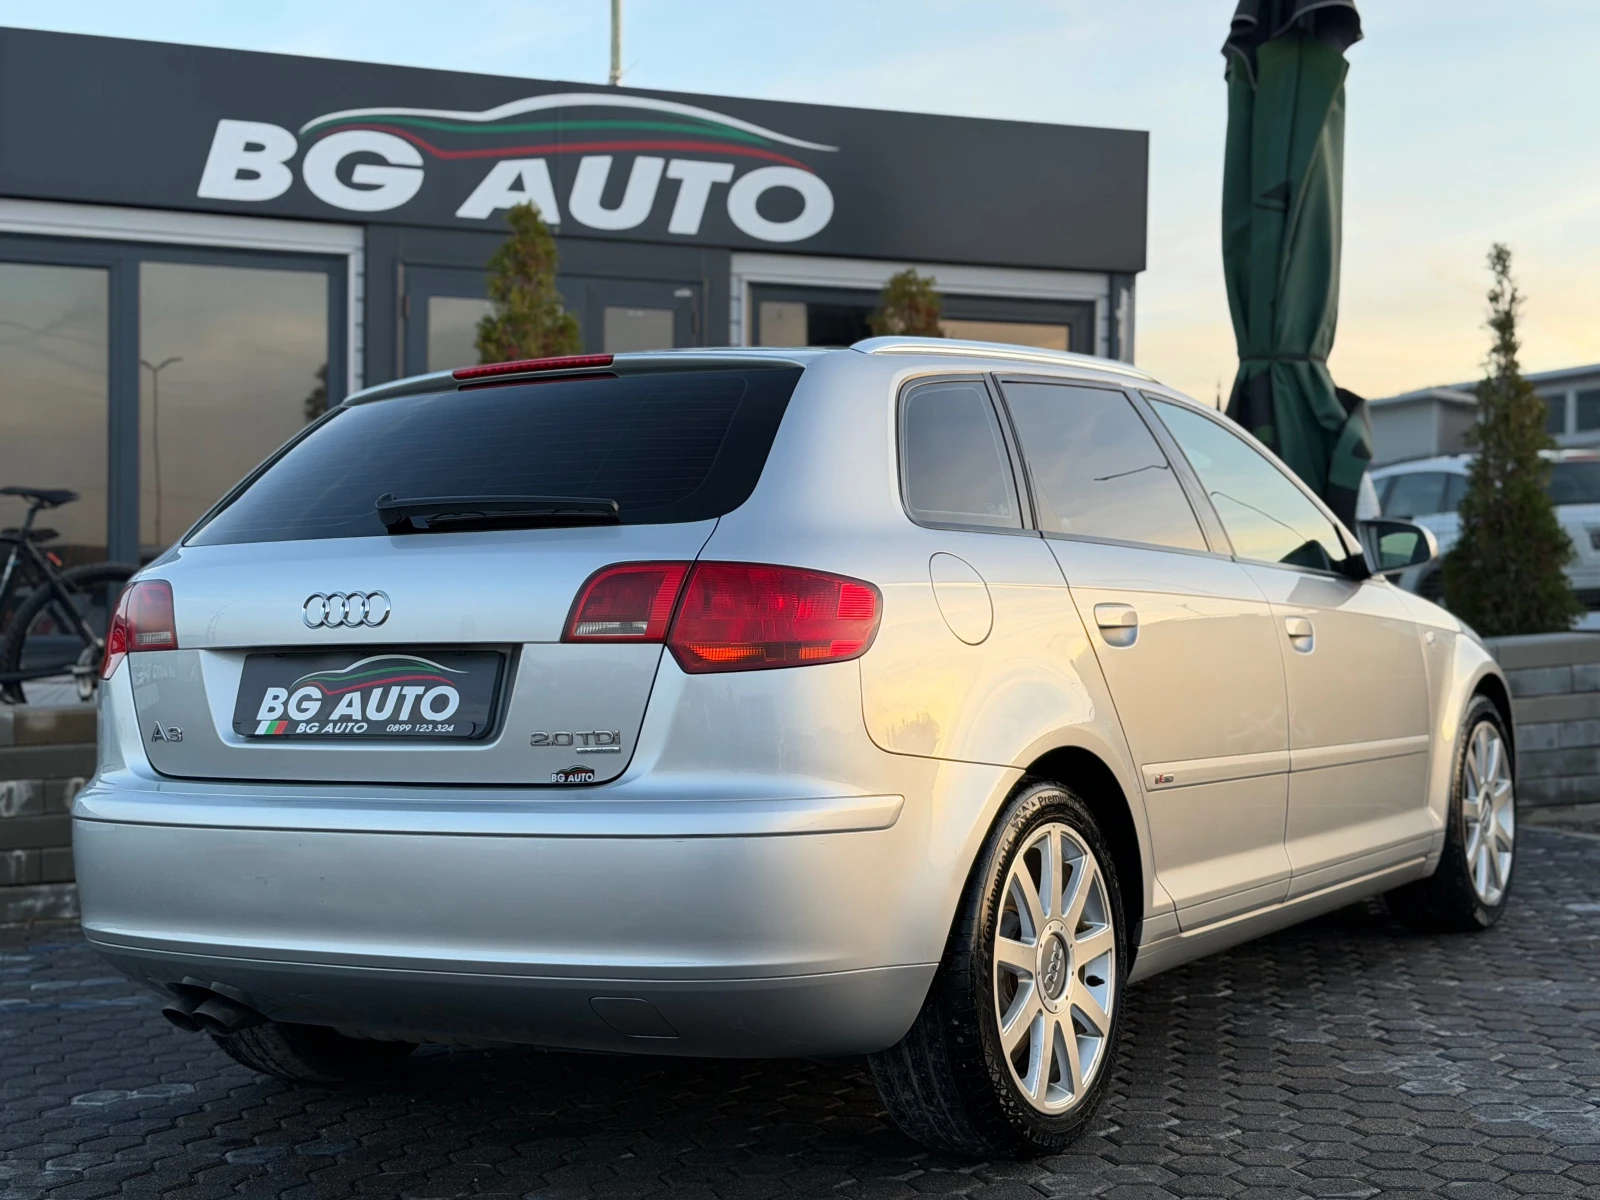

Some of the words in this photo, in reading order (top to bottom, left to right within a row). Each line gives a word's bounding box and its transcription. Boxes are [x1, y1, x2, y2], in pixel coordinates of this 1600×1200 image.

[197, 118, 424, 212] BG
[455, 154, 835, 242] AUTO
[256, 686, 322, 721] BG
[328, 685, 460, 722] AUTO
[151, 719, 184, 743] A3
[295, 722, 321, 734] BG
[321, 722, 369, 734] AUTO
[386, 723, 412, 732] 0899
[414, 723, 432, 732] 123
[434, 723, 455, 732] 324
[530, 730, 574, 747] 2.0
[551, 773, 565, 783] BG
[567, 773, 594, 783] AUTO
